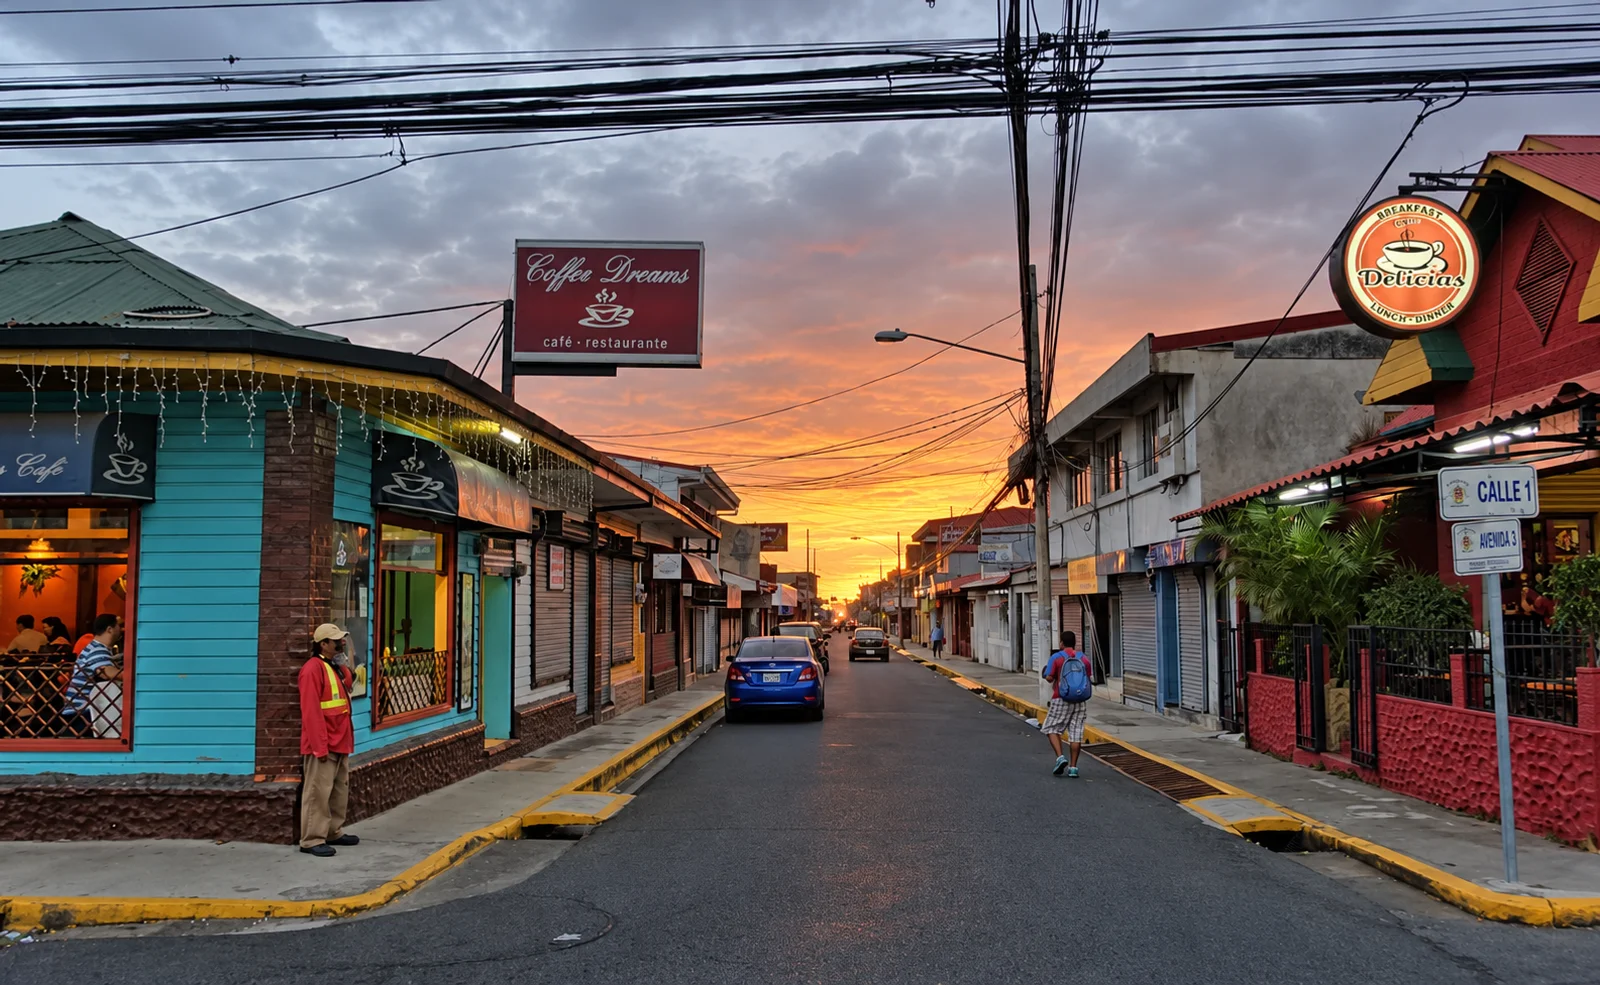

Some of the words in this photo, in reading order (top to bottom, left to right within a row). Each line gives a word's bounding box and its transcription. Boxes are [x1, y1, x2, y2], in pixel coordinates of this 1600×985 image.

[1376, 204, 1443, 219] BREAKFAST
[599, 254, 690, 284] Dreams
[1358, 269, 1465, 287] Delicias
[1370, 302, 1407, 323] LUNCH
[1415, 302, 1455, 323] DINNER
[543, 335, 572, 348] café
[585, 338, 668, 349] restaurante
[16, 453, 68, 483] Café
[1477, 480, 1521, 502] CALLE
[1525, 481, 1531, 501] 1
[1480, 531, 1510, 549] AVENIDA
[1511, 530, 1517, 546] 3
